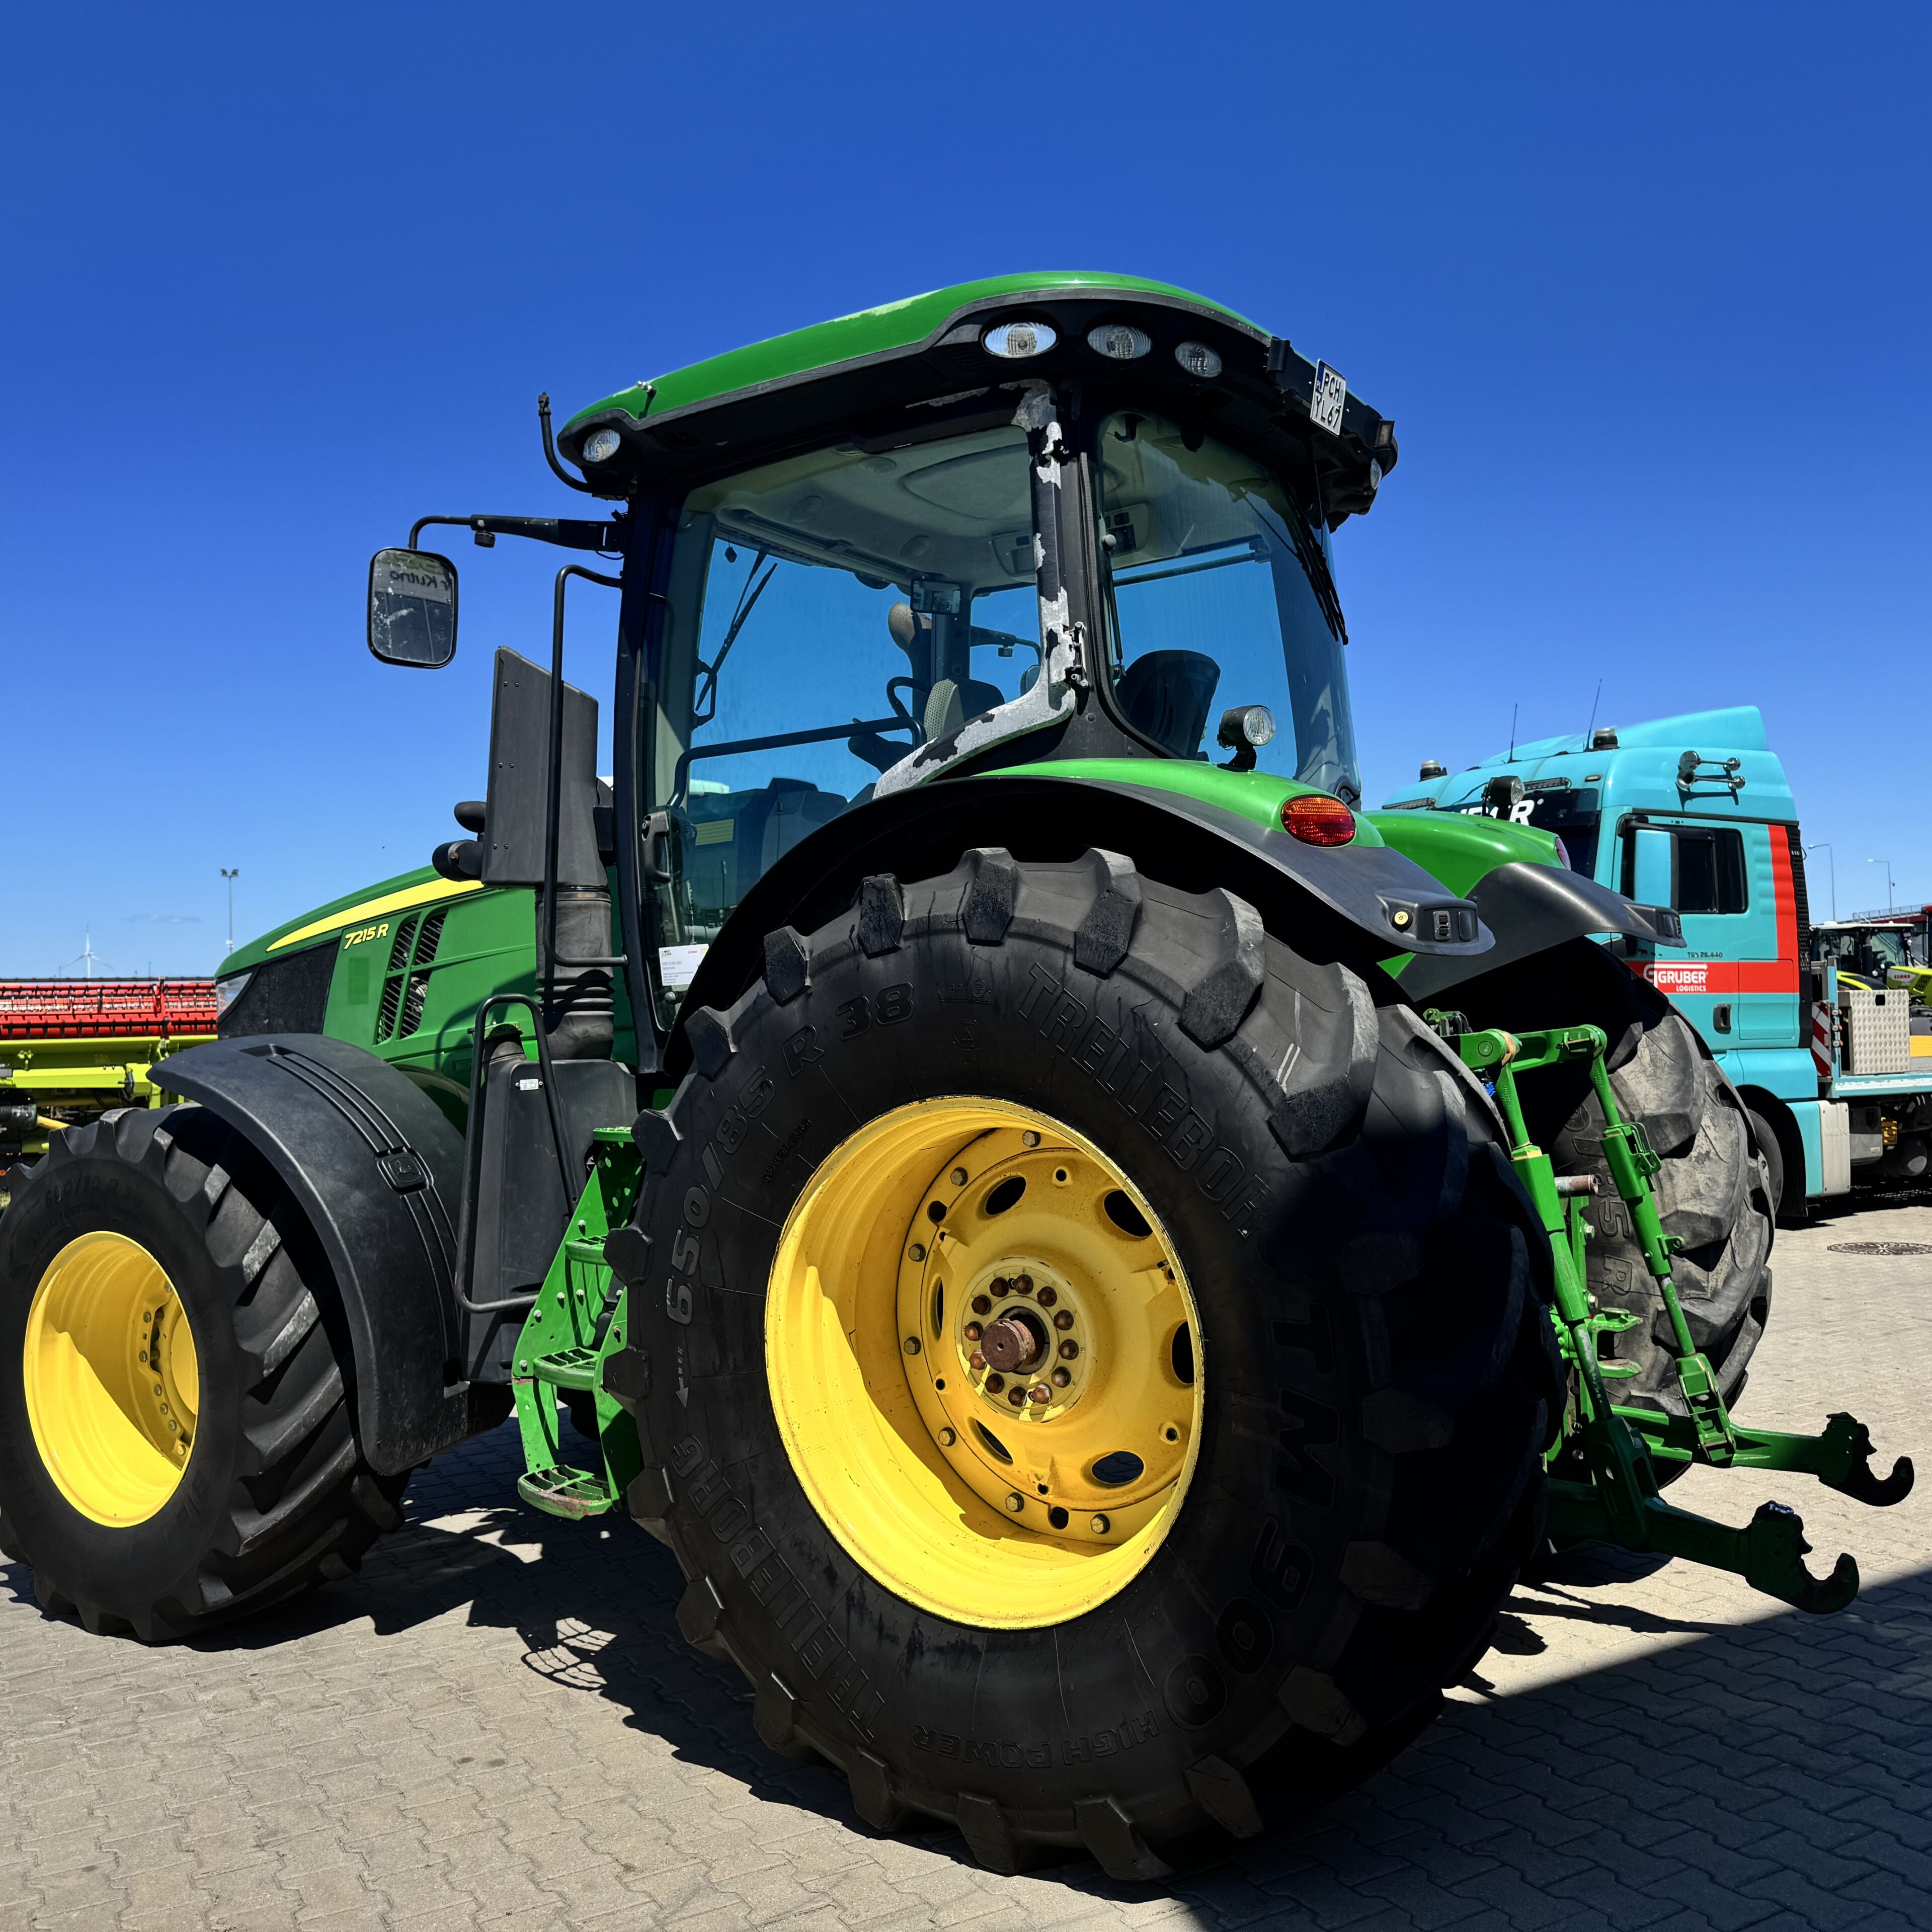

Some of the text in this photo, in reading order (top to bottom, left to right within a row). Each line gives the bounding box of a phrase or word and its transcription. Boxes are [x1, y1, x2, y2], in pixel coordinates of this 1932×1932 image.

[1323, 371, 1341, 403] PCH
[1657, 971, 1707, 984] GRUBER
[666, 1065, 775, 1326] 650/85
[781, 1024, 825, 1078] R
[836, 982, 915, 1041] 38
[671, 1433, 886, 1744] TRELLEBORG
[911, 1710, 1161, 1769] HIGH POWER
